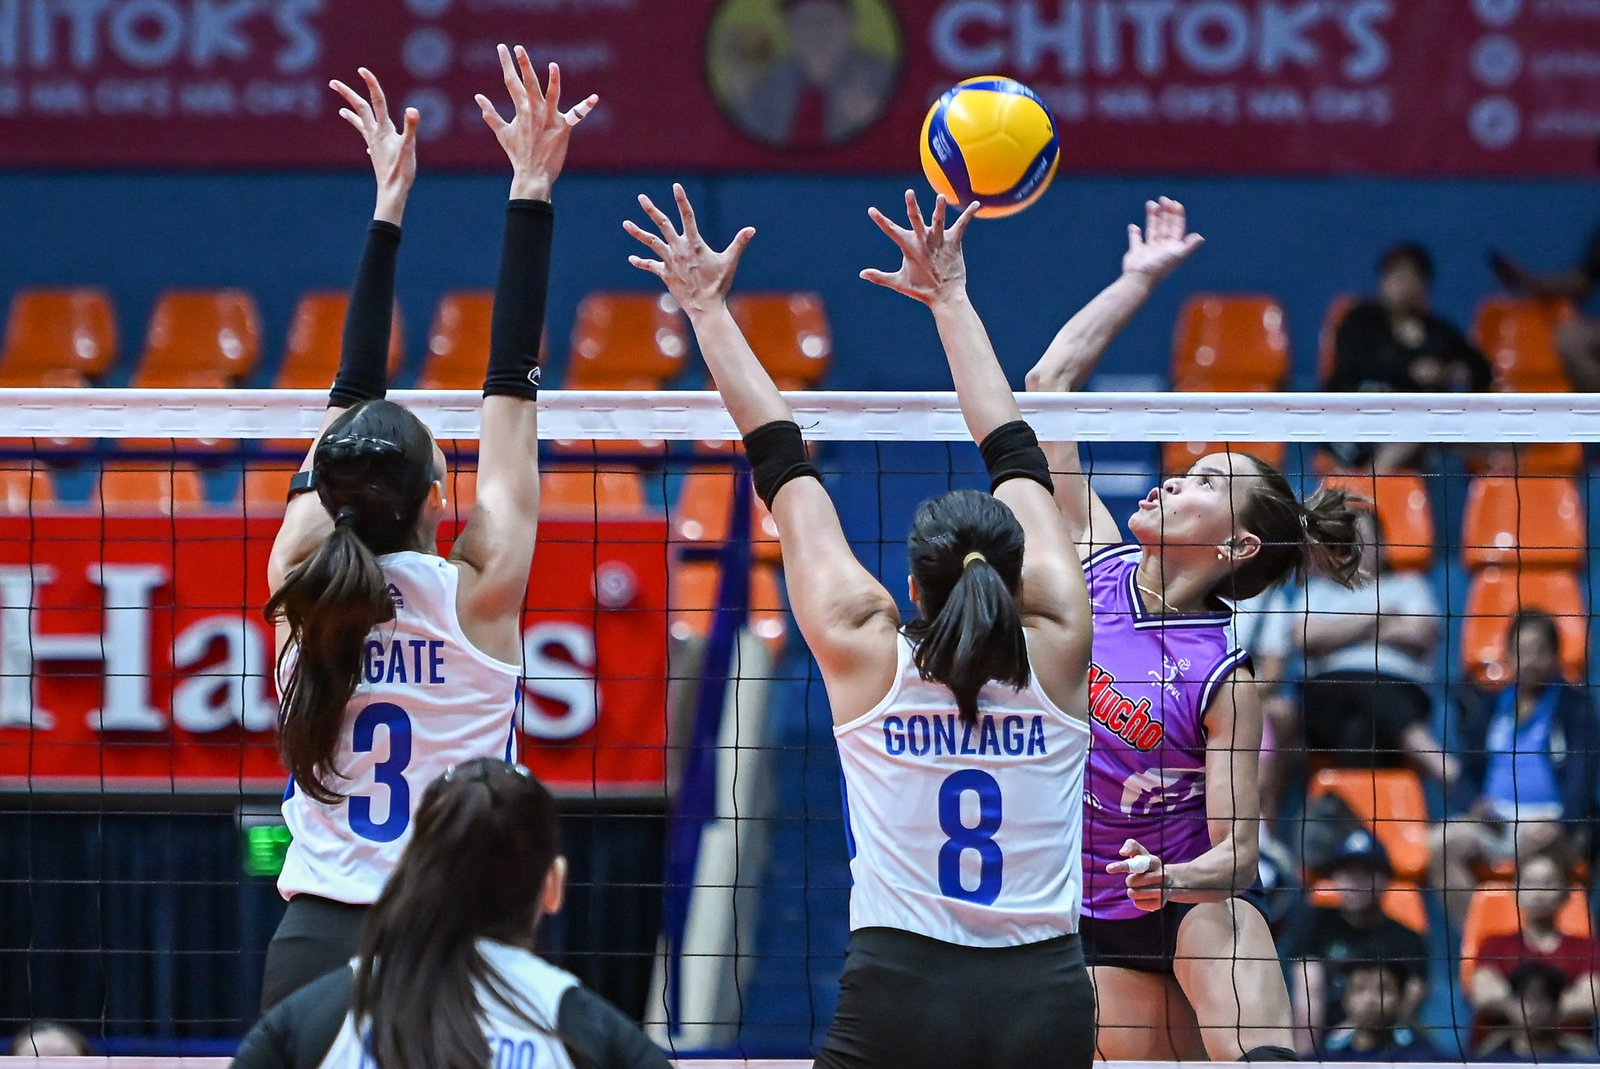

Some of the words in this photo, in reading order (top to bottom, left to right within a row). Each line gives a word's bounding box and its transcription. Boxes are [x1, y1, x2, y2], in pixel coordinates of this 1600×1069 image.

[363, 640, 445, 684] GATE
[883, 714, 1047, 757] GONZAGA
[1089, 665, 1163, 750] Mucho
[348, 702, 412, 843] 3
[938, 769, 1003, 906] 8
